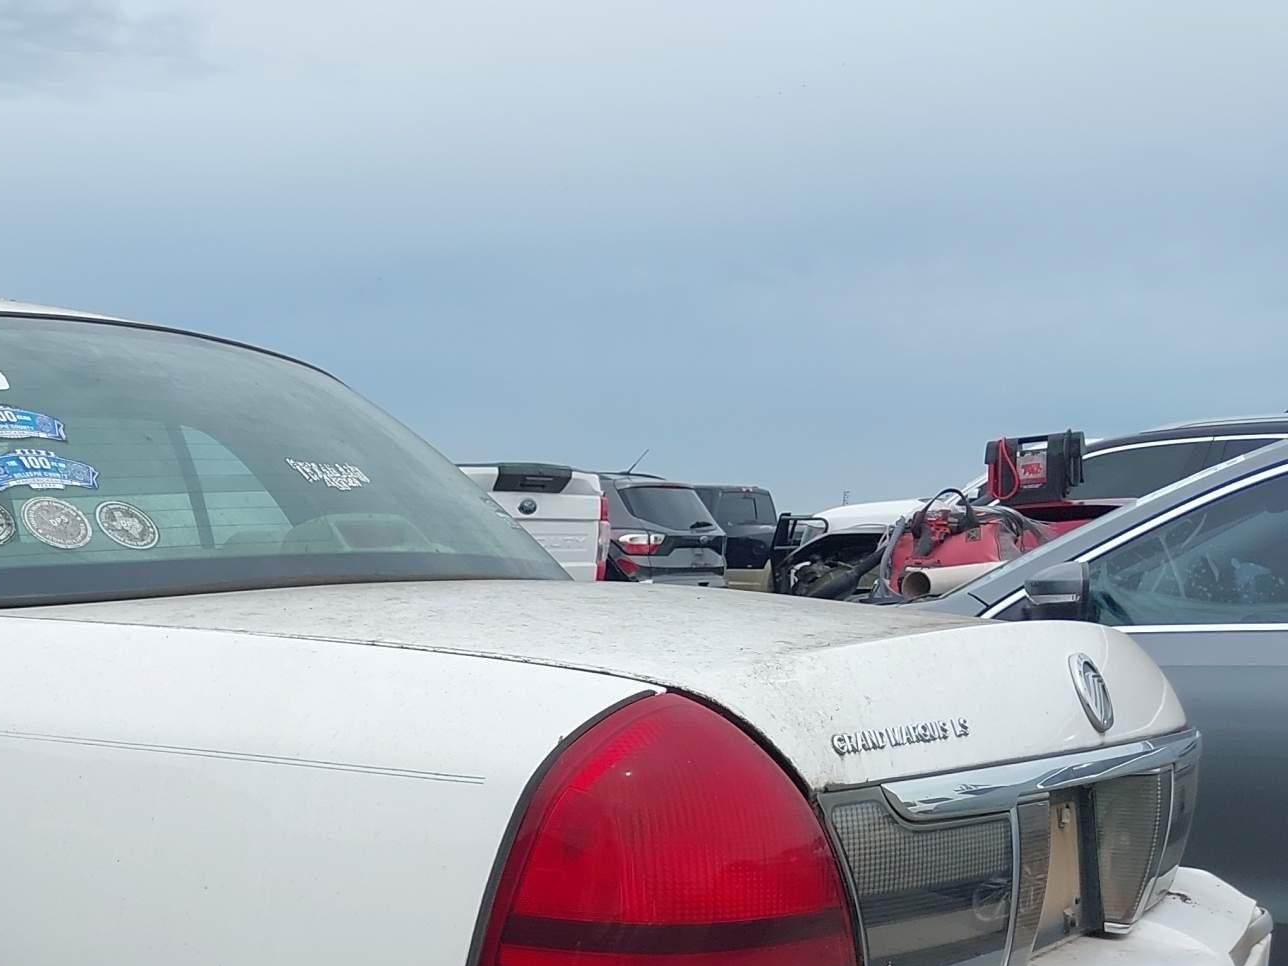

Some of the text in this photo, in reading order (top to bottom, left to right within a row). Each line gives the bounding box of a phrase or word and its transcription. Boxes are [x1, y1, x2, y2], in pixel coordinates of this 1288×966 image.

[19, 456, 52, 470] 100
[832, 728, 886, 756] GRAND
[950, 717, 970, 738] LS
